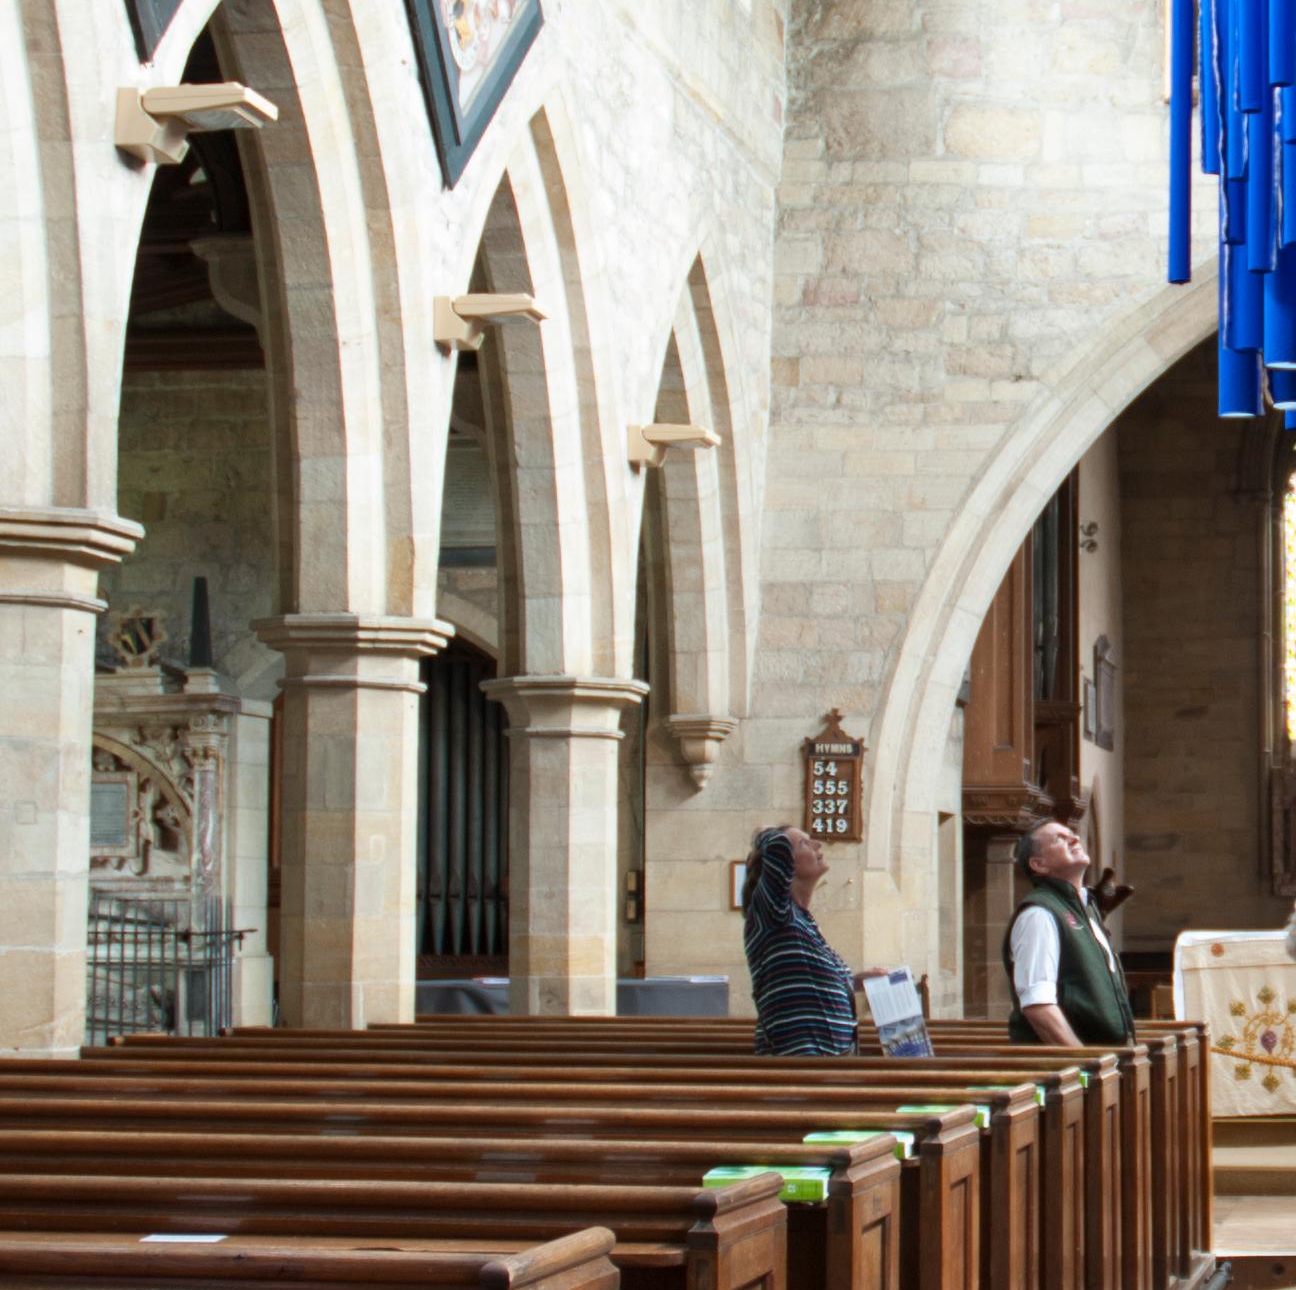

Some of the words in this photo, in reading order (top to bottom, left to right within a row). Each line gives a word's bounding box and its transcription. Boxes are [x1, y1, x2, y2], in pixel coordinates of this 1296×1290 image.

[815, 743, 853, 753] HYMNS
[813, 761, 837, 776] 54
[813, 780, 848, 795] 555
[812, 799, 848, 814] 337
[812, 818, 848, 833] 419
